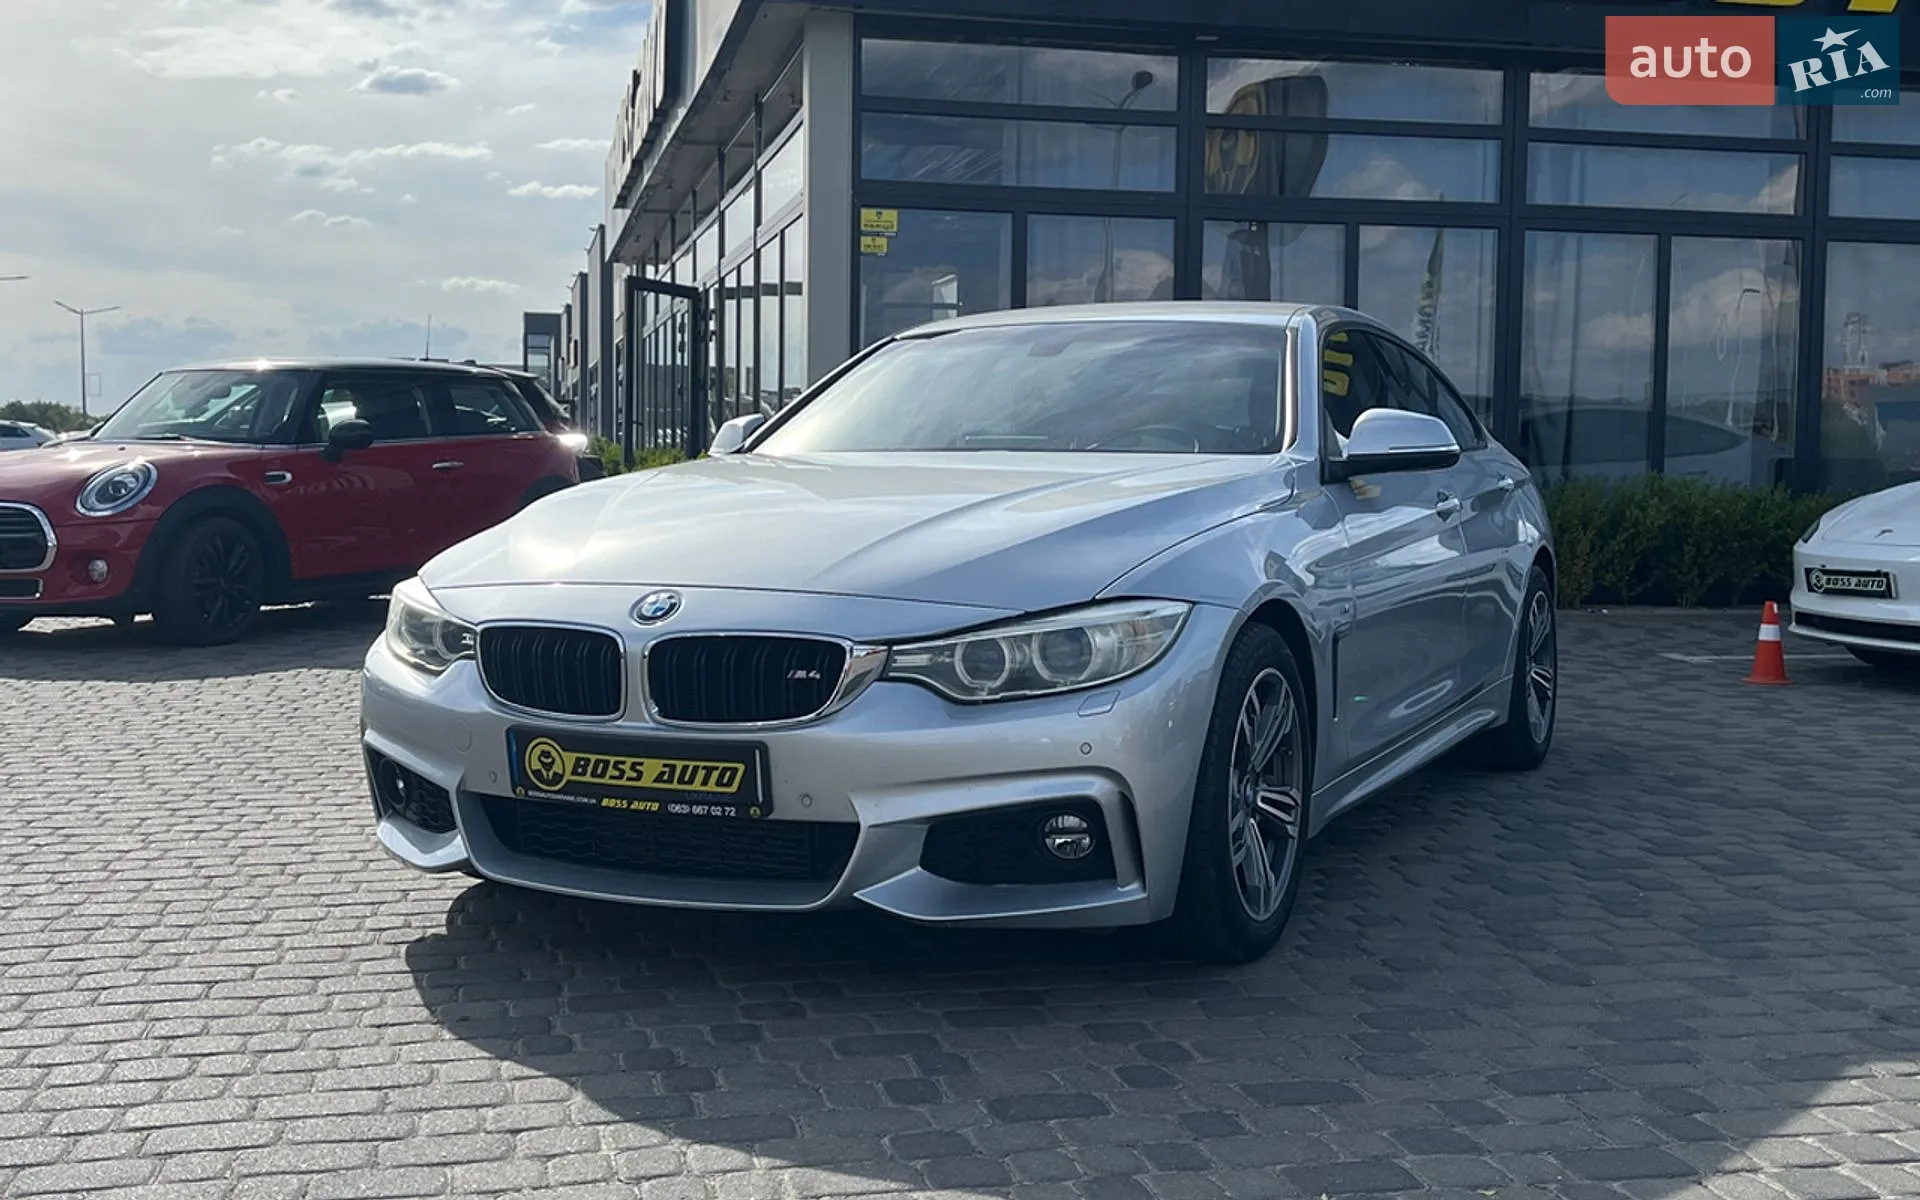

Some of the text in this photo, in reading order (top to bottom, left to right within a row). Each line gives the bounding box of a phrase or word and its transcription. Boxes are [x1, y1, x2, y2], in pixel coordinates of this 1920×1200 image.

[1825, 577, 1884, 589] BOSS AUTO
[571, 756, 739, 788] BOSS AUTO
[601, 797, 628, 808] BOSS
[630, 800, 660, 811] AUTO
[667, 803, 691, 814] (063)
[709, 806, 723, 816] 02
[724, 807, 737, 817] 72
